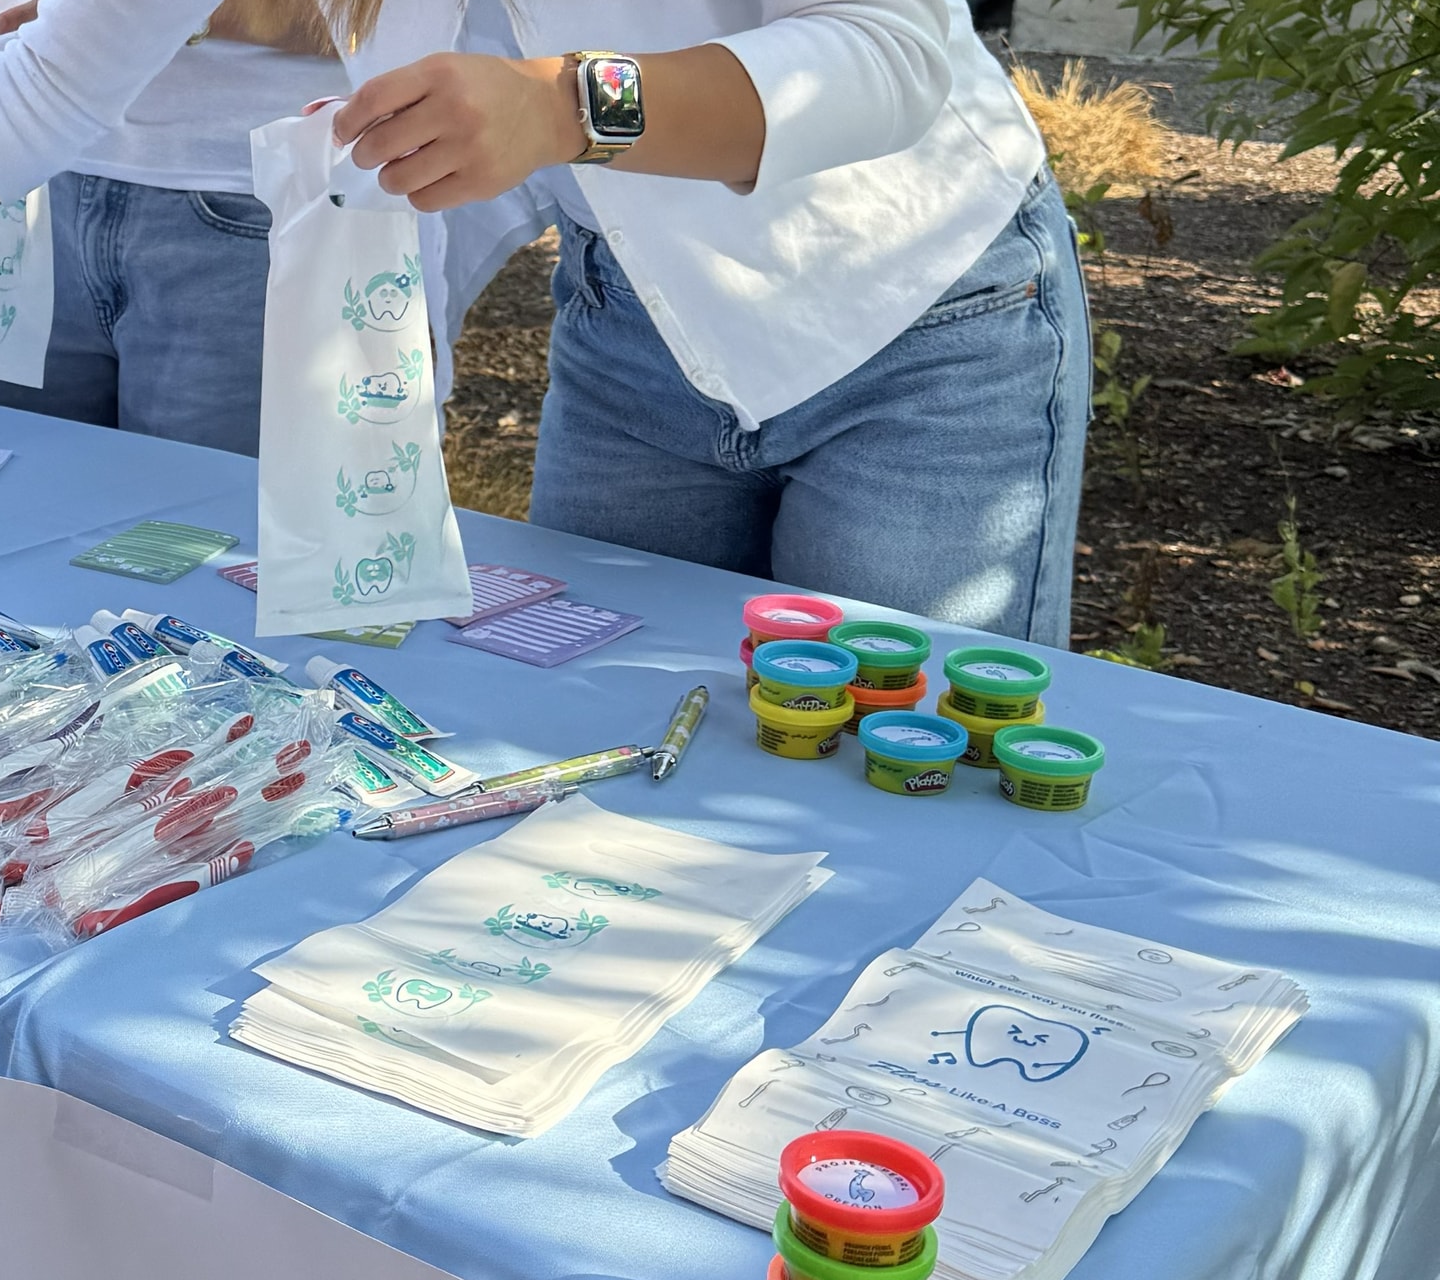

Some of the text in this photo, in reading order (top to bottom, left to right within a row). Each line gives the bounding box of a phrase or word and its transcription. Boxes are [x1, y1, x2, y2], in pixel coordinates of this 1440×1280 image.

[102, 642, 126, 670] Crest
[126, 626, 157, 657] Crest
[350, 671, 385, 702] Crest
[352, 715, 397, 745] Crest
[955, 969, 995, 987] Which
[999, 983, 1029, 996] ever
[1031, 993, 1059, 1006] way
[1061, 1003, 1086, 1016] you
[867, 1060, 1063, 1130] Floss Like A Boss
